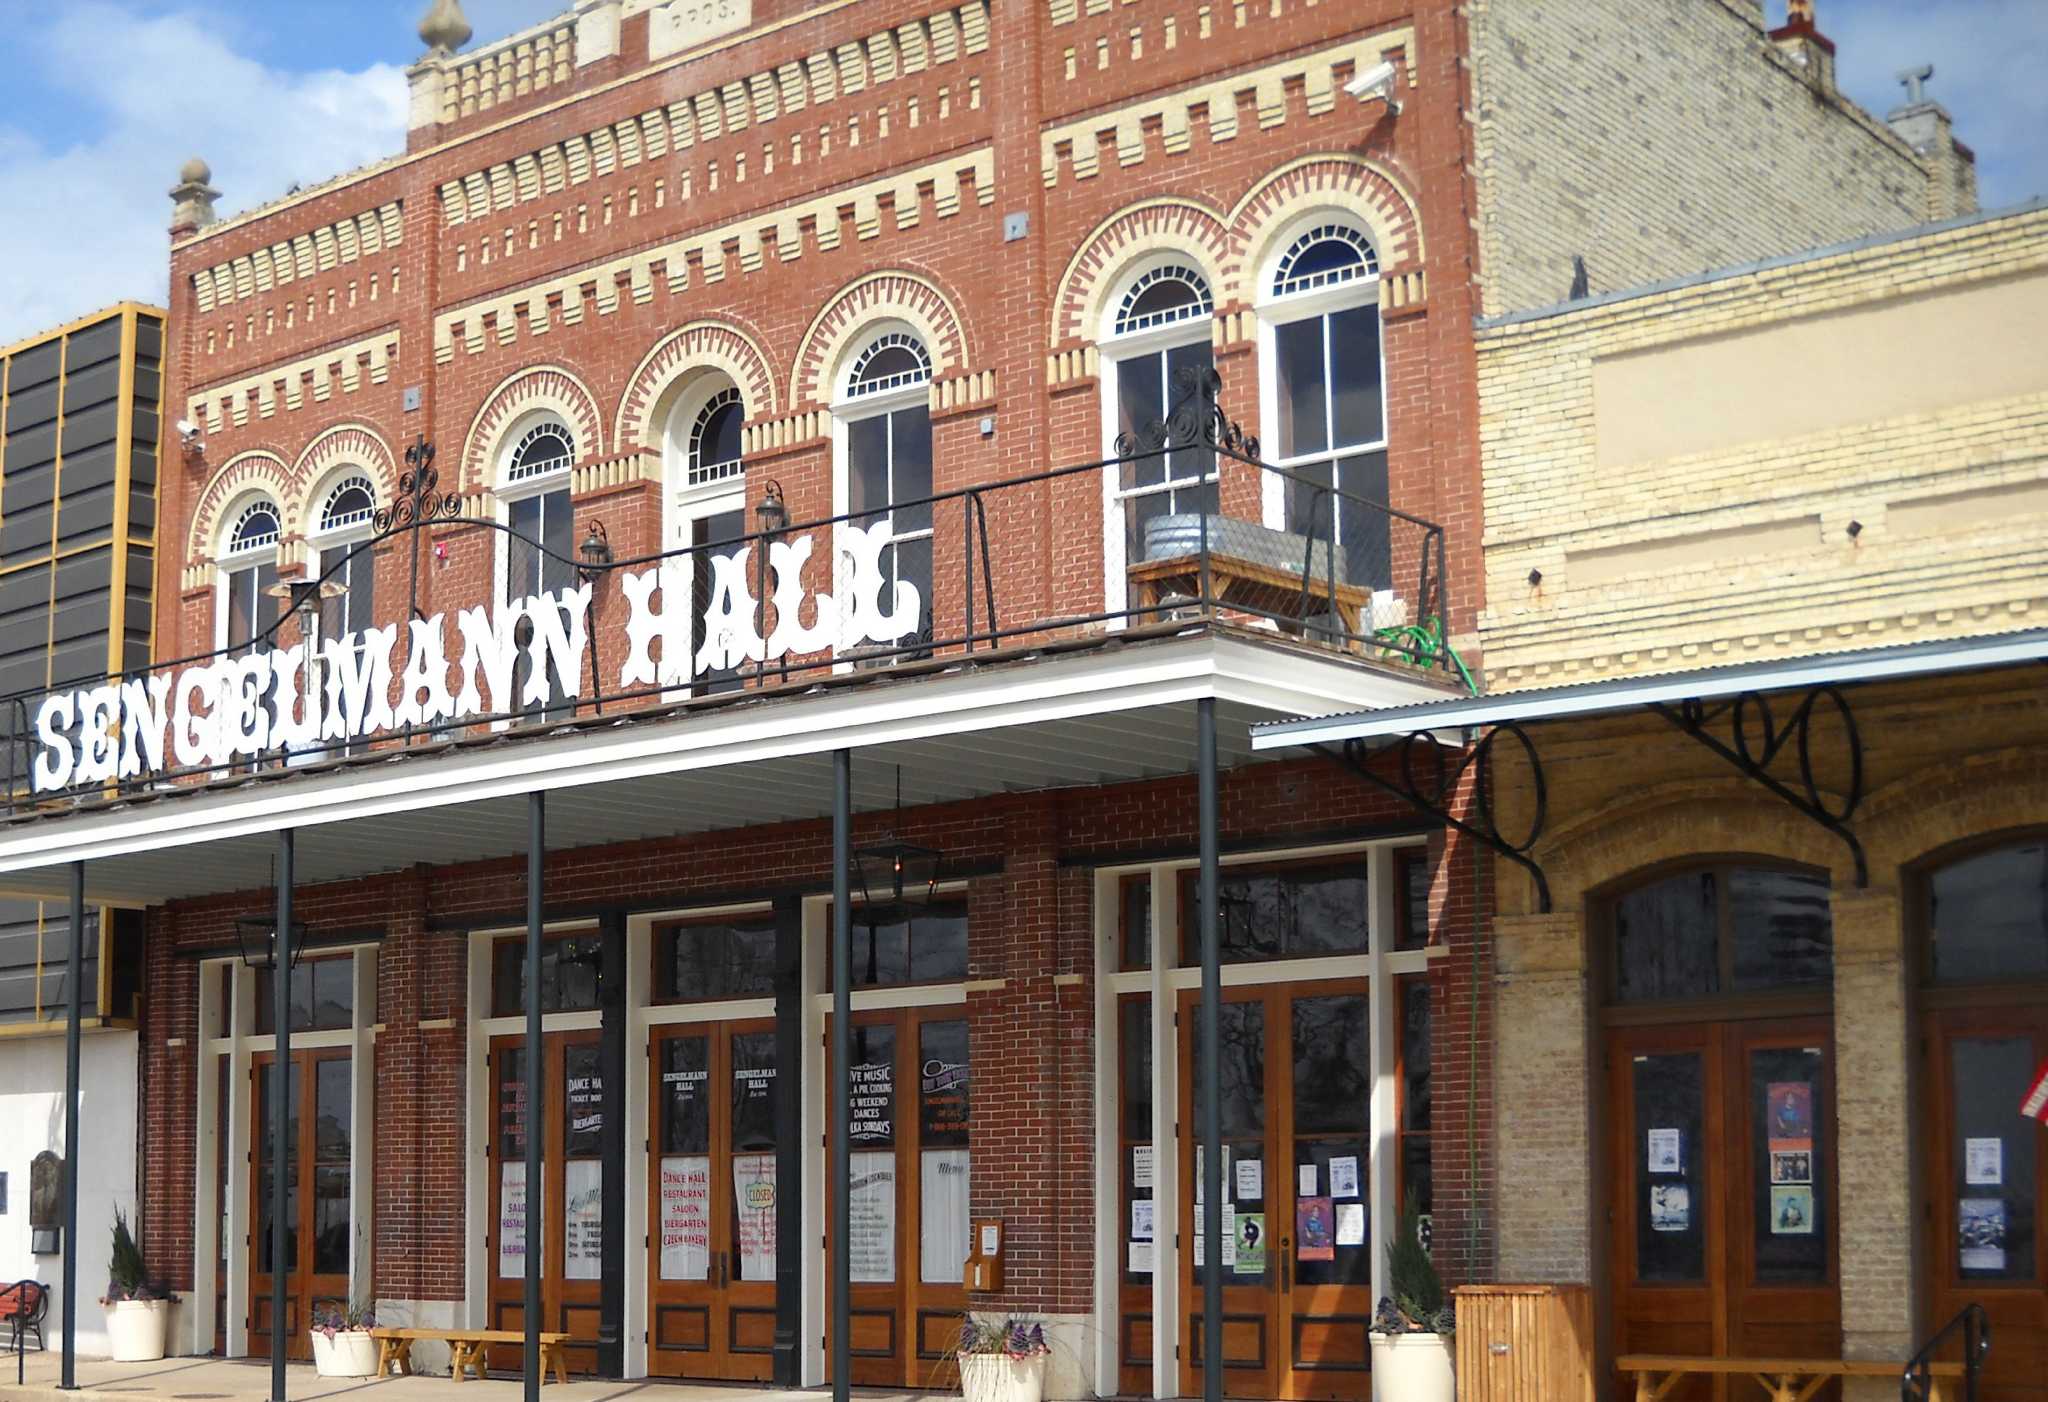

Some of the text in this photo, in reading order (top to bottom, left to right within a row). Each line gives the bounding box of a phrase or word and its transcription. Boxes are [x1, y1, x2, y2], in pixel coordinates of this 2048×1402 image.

[34, 519, 921, 794] SENGELMANN HALL
[863, 1066, 891, 1081] MUSIC
[568, 1077, 602, 1092] DANCE HA
[676, 1082, 694, 1091] HALL
[748, 1079, 768, 1089] HALL
[856, 1097, 888, 1107] WEEKEND
[854, 1108, 880, 1119] DANCES
[573, 1113, 602, 1129] BIERGARTE
[849, 1120, 890, 1135] LKA SUNDAYS
[663, 1171, 706, 1183] DANCE HALL
[663, 1189, 706, 1199] RESTAURANT
[749, 1189, 772, 1202] CLOSED
[507, 1203, 527, 1213] SALO
[672, 1204, 699, 1214] SALOON
[664, 1219, 707, 1229] BIERGARTEN
